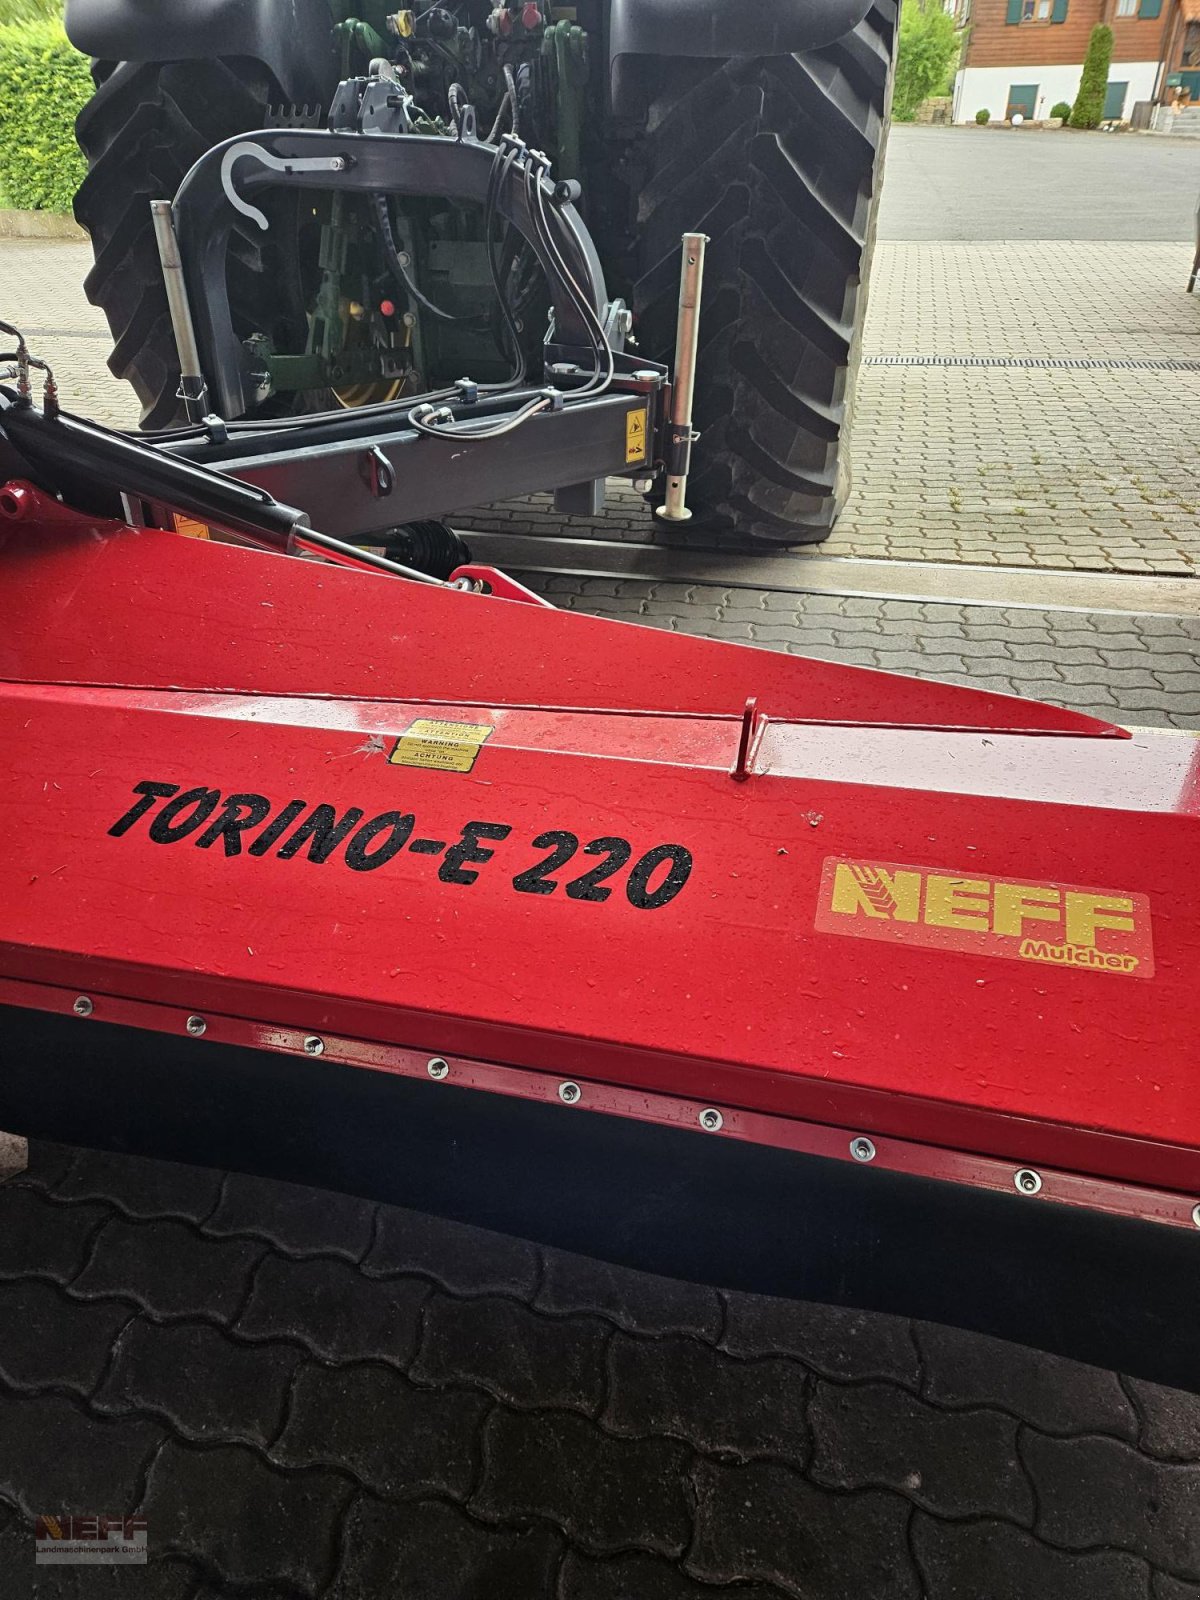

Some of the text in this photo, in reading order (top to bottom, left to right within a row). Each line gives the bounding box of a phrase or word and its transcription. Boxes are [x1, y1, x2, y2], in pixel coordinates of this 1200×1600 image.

[414, 752, 454, 761] ACHTUNG
[421, 739, 459, 748] WARNING
[107, 780, 693, 909] TORINO-E 220
[830, 863, 1135, 947] NEFF
[1022, 940, 1137, 972] Mulcher
